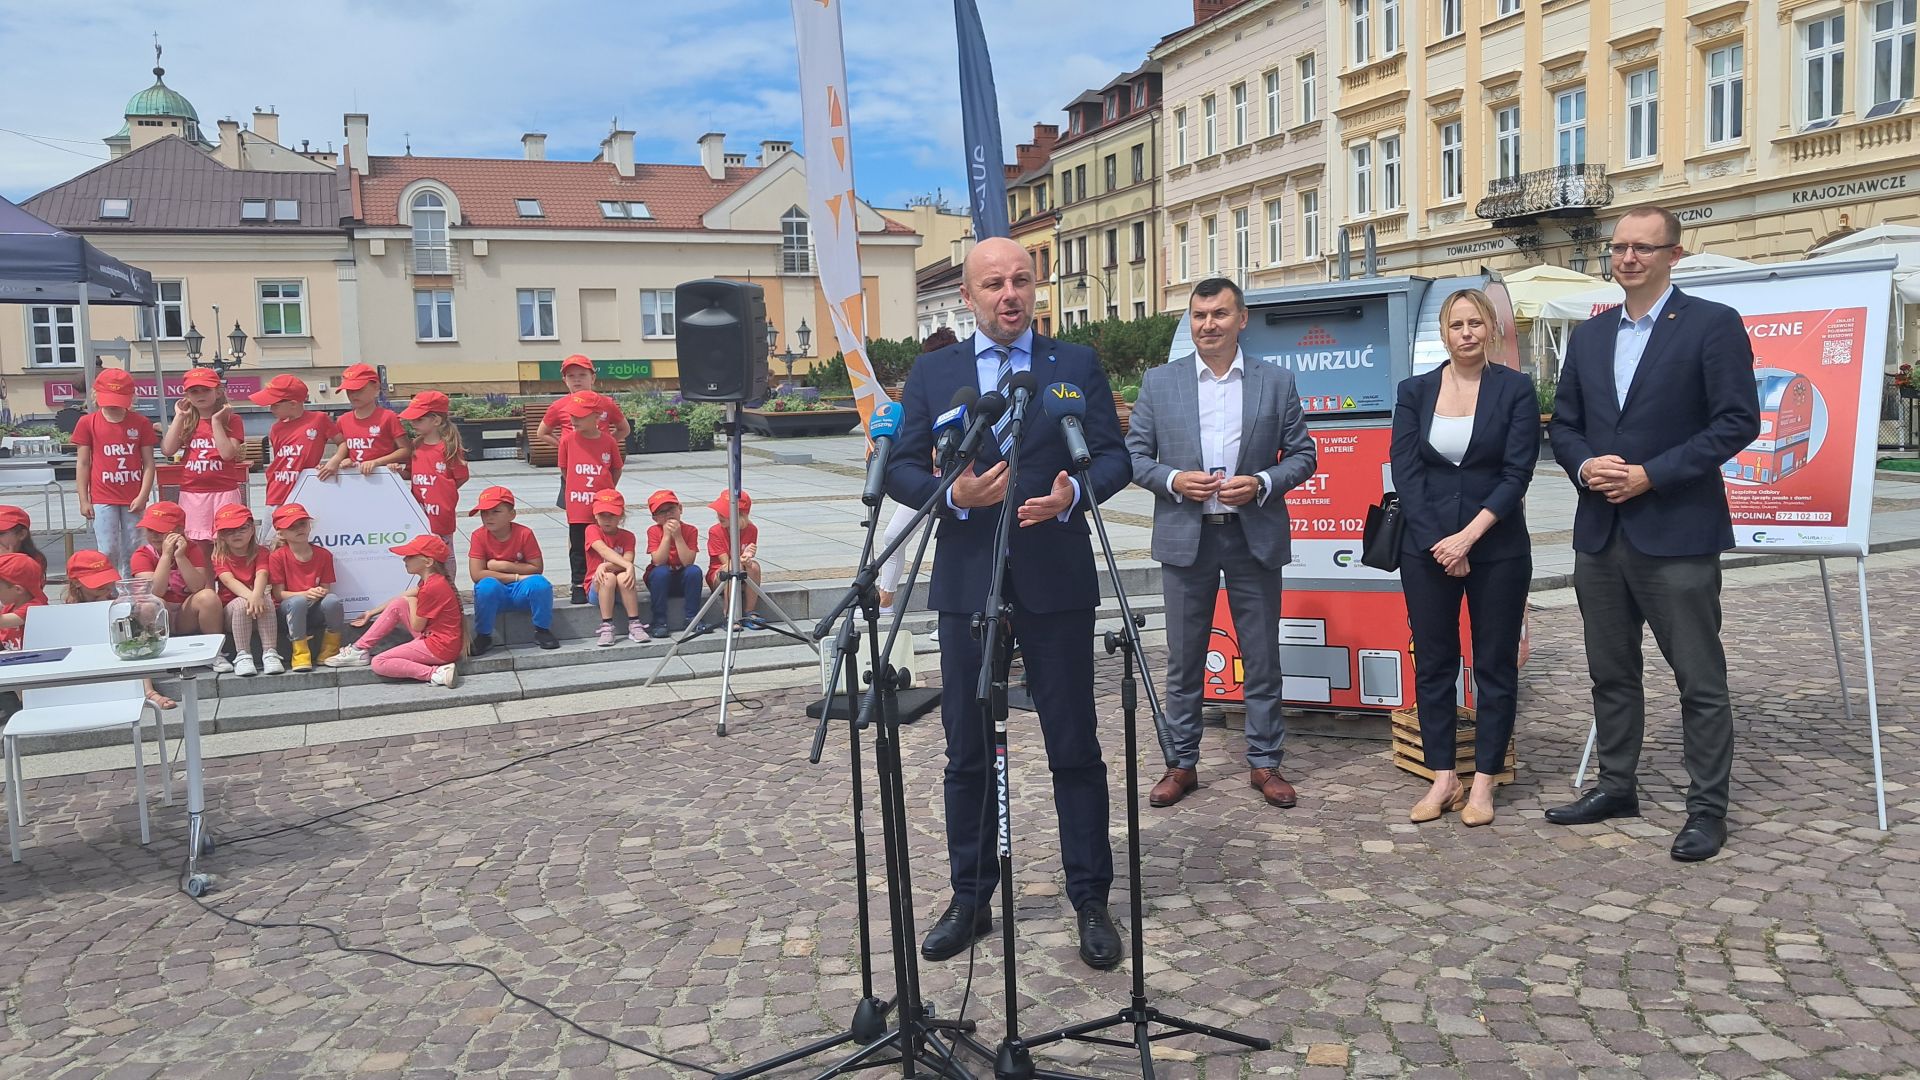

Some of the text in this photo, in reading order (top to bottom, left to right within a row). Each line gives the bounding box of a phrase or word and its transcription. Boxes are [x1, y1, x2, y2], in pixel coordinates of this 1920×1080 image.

[1447, 240, 1504, 256] TOWARZYSTWO
[1792, 175, 1907, 203] KRAJOZNAWCZE
[1296, 344, 1374, 372] WRZUĆ
[607, 363, 649, 375] żabka
[167, 385, 185, 396] NO
[1051, 384, 1080, 399] Via
[347, 437, 375, 450] ORŁY
[1330, 436, 1358, 444] WRZUĆ
[103, 443, 135, 456] ORŁY
[197, 450, 208, 459] Z
[277, 444, 304, 457] ORŁY
[356, 450, 364, 461] Z
[117, 457, 127, 469] Z
[185, 460, 223, 475] PIĄTKI
[286, 457, 294, 469] Z
[575, 464, 603, 476] ORŁY
[274, 470, 300, 485] PIĄT
[412, 474, 437, 487] ORŁY
[586, 477, 594, 488] Z
[419, 487, 427, 499] Z
[570, 491, 595, 506] PIĄT
[1312, 519, 1336, 532] 102
[1340, 519, 1364, 532] 102
[311, 532, 408, 547] AURAEKO
